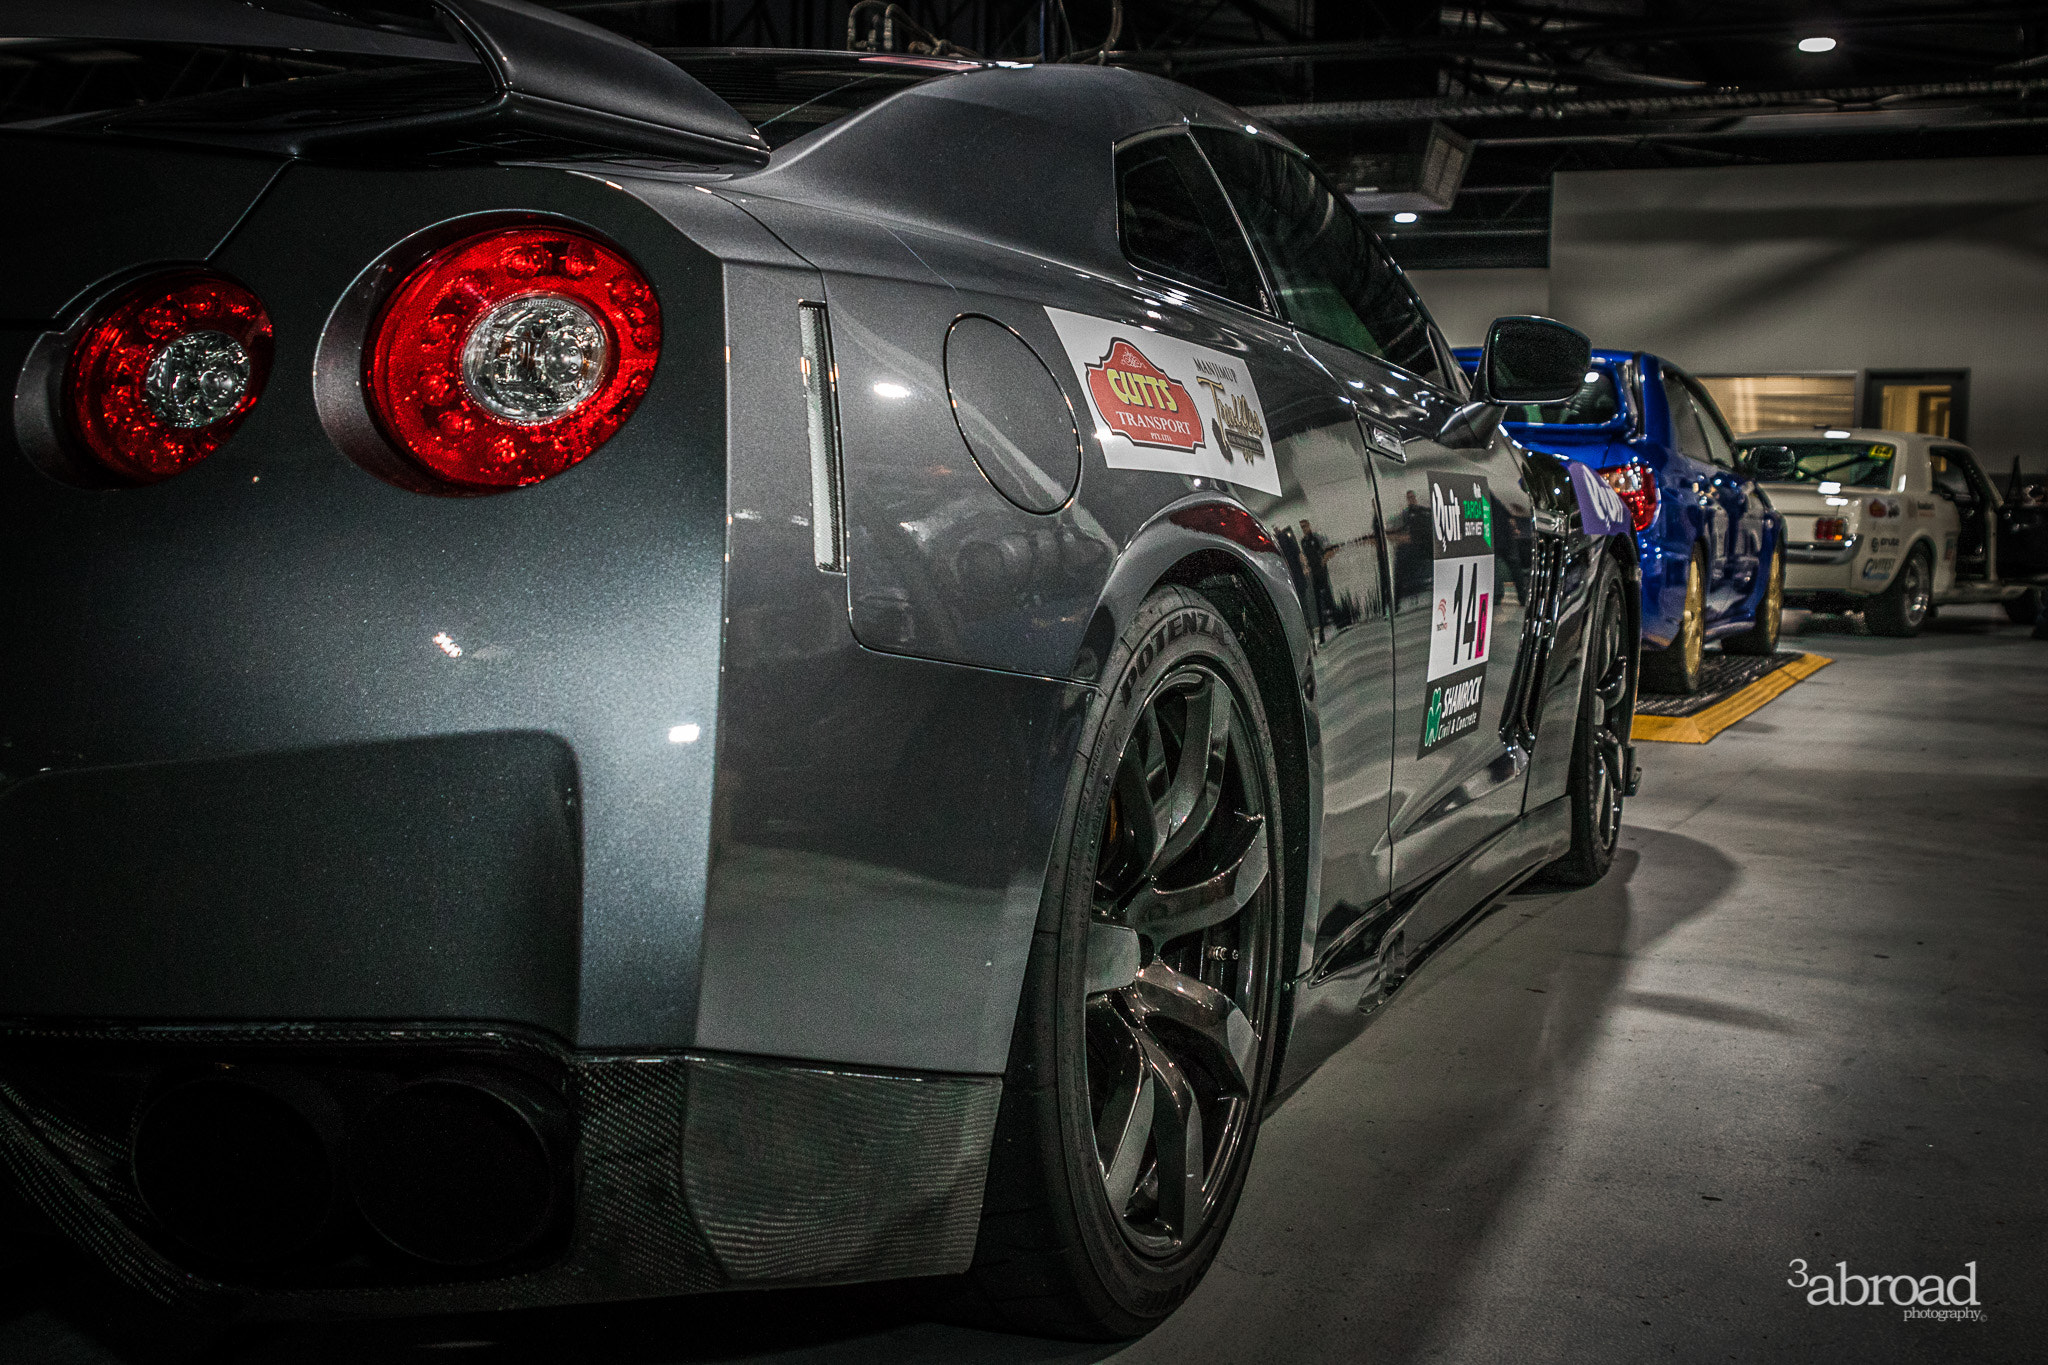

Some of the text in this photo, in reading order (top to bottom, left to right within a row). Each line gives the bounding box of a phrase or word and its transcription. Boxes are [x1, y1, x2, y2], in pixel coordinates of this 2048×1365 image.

[1106, 368, 1178, 413] CUTTS
[1116, 411, 1191, 434] TRANSPORT
[1432, 483, 1461, 552] Quit
[1453, 563, 1478, 666] 14
[1120, 611, 1229, 708] POTENZA
[1441, 675, 1483, 718] SHAMROCK
